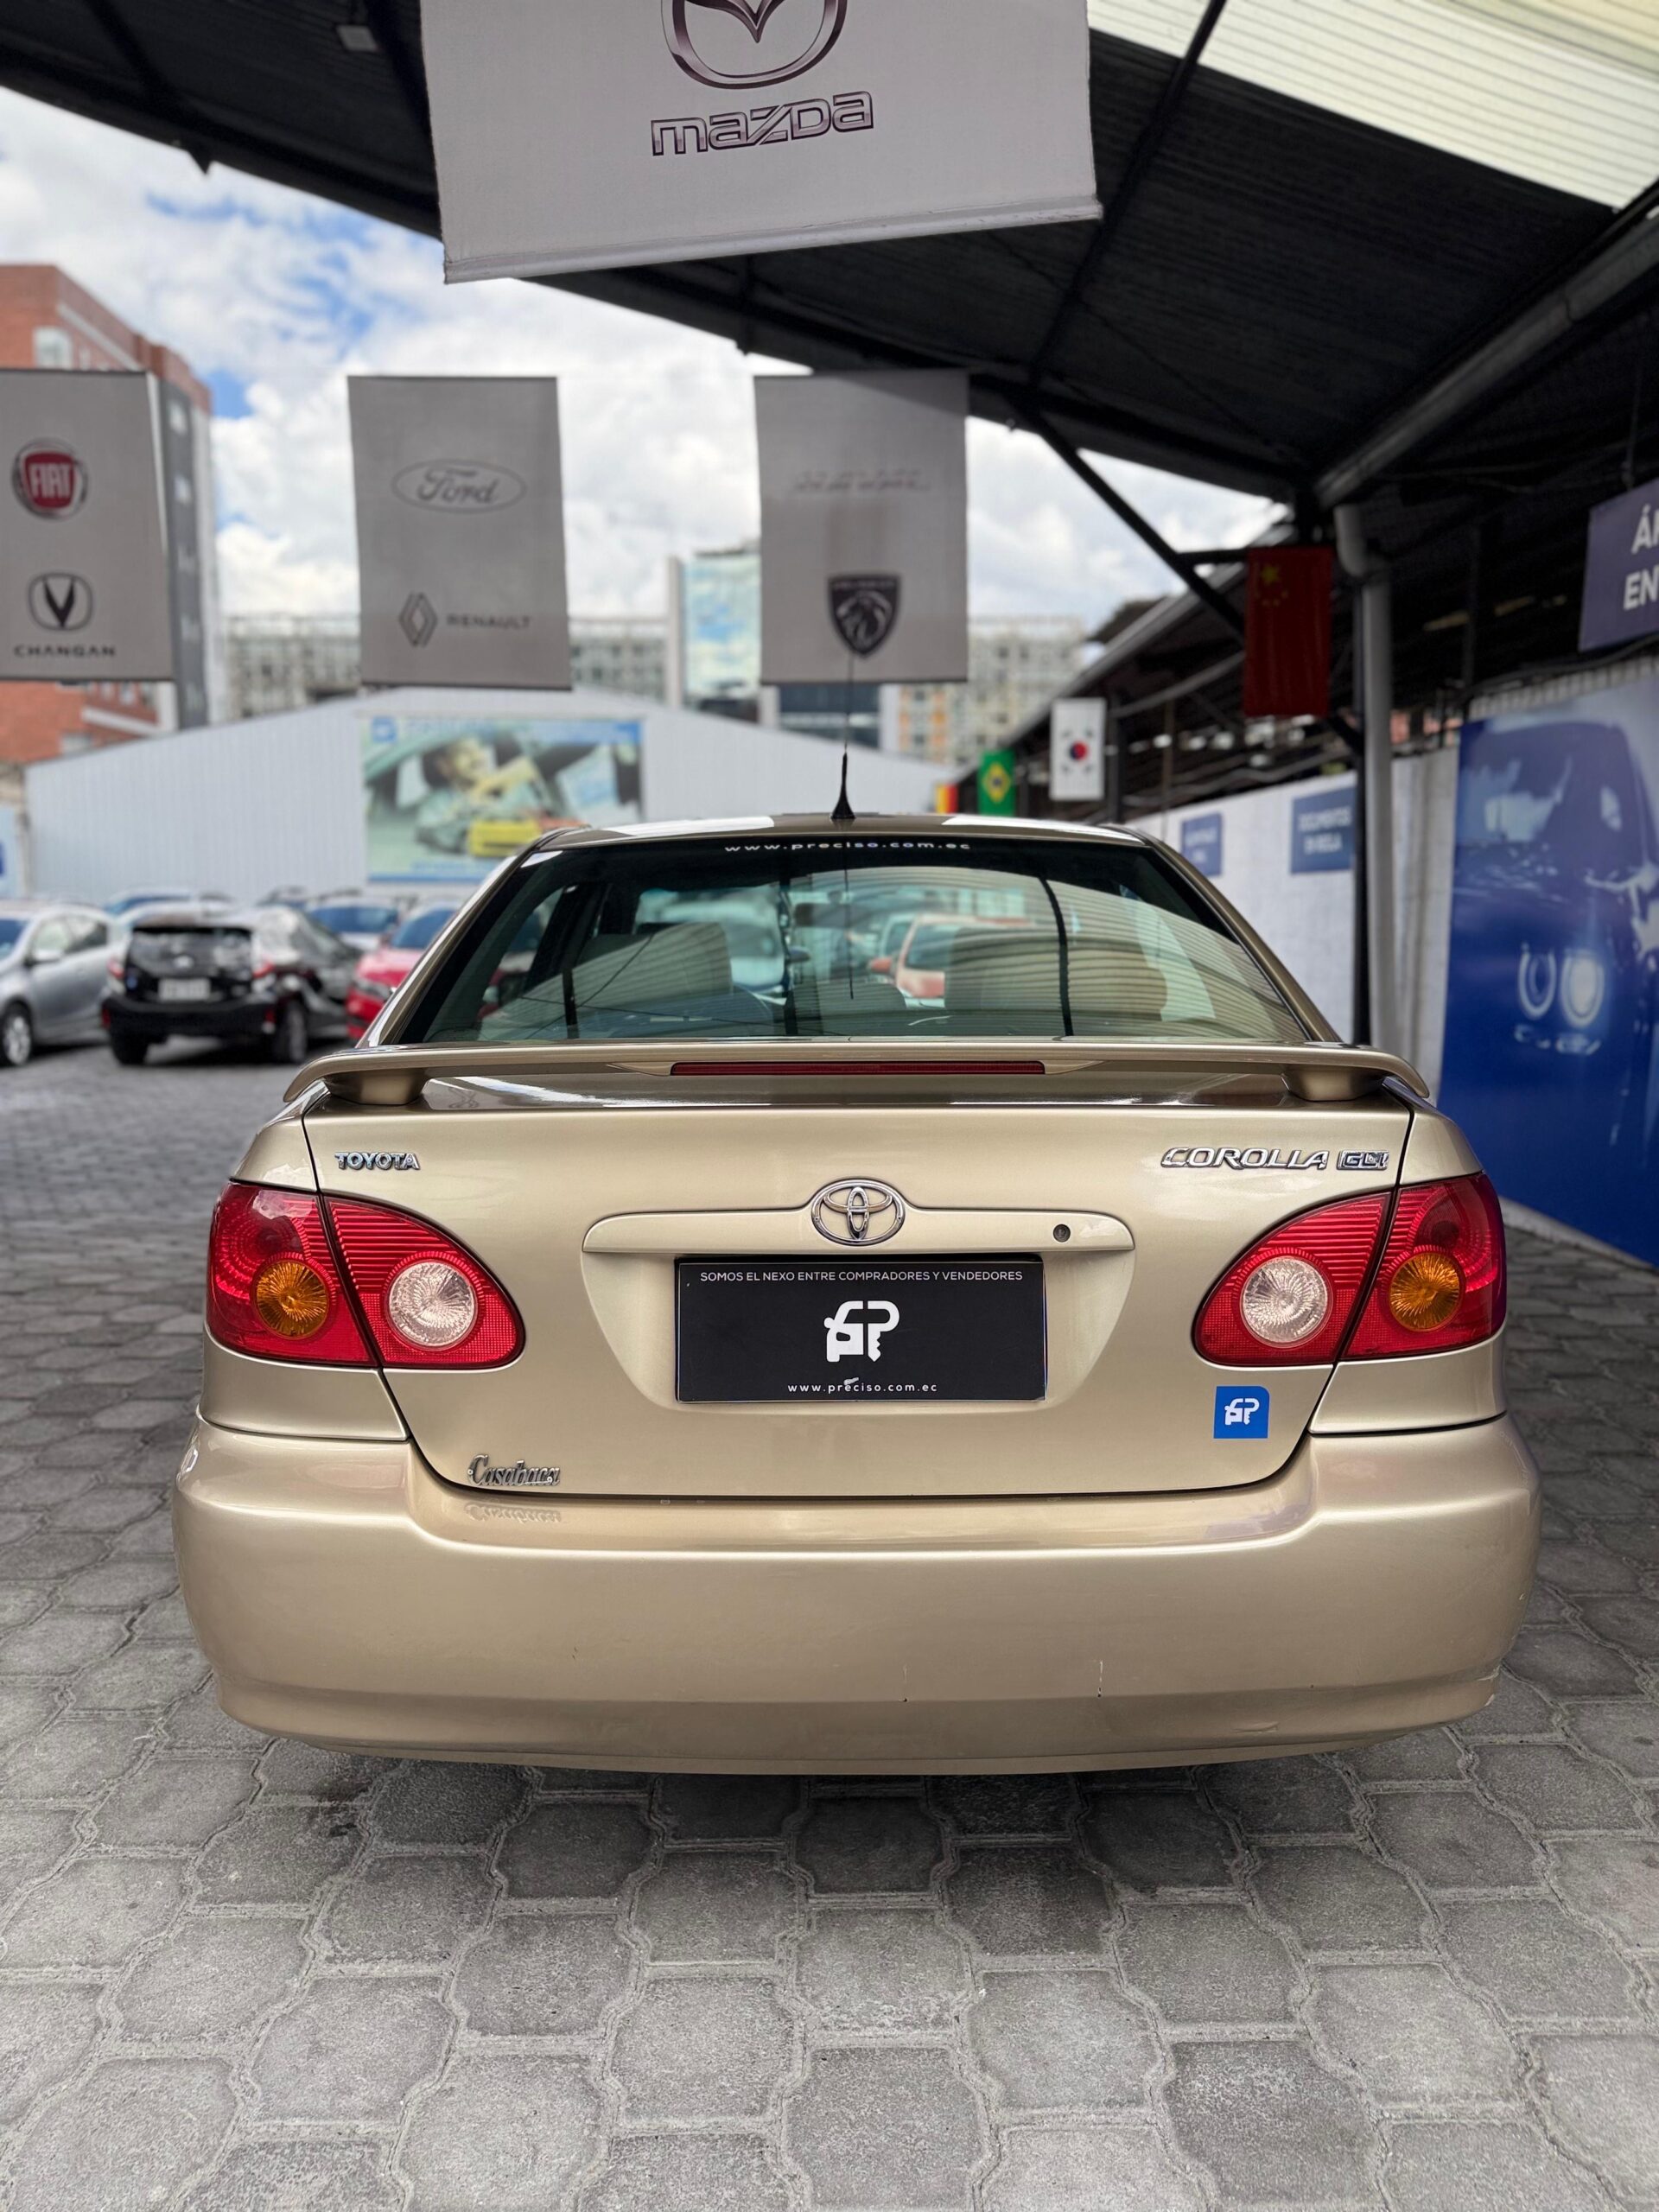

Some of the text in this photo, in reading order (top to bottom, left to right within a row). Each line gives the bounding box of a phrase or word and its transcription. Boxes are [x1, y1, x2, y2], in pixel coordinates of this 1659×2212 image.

[29, 461, 72, 499] FIAT
[416, 467, 499, 505] Ford
[1630, 503, 1659, 555] Á
[447, 613, 531, 630] RENAULT
[13, 644, 116, 658] CHANGAN
[724, 841, 971, 852] www.preciso.com.ec
[334, 1151, 421, 1171] TOYOTA
[1161, 1147, 1330, 1170] COROLLA
[700, 1271, 1024, 1282] SOMOS EL NEXO ENTRE COMPRADORES Y VENDEDORES
[787, 1382, 938, 1395] www.preciso.com.ec
